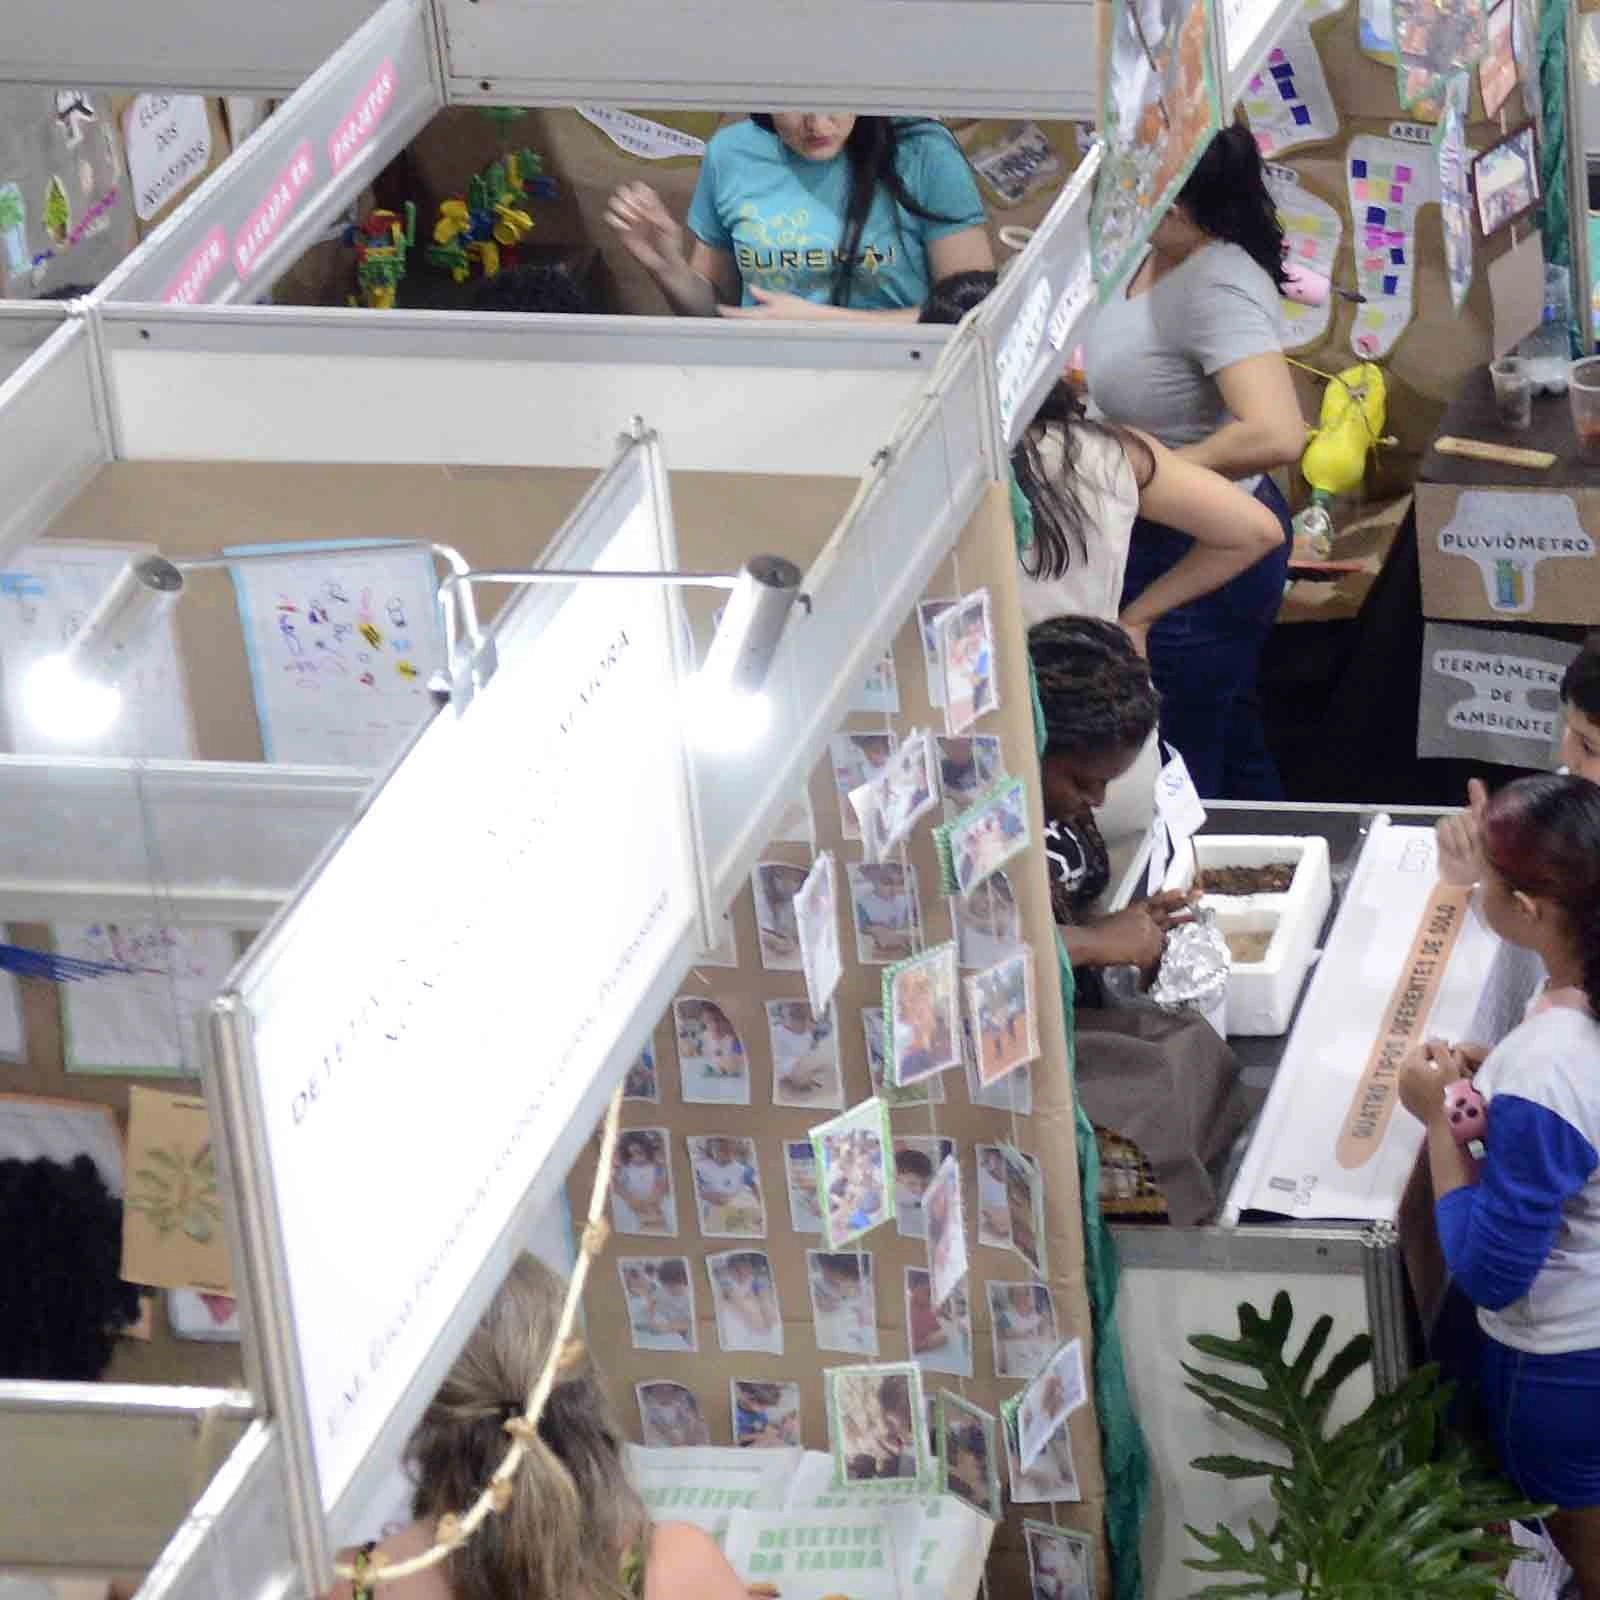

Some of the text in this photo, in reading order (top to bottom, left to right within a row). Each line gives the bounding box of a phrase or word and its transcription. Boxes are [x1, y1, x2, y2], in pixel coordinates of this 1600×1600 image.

[1393, 125, 1430, 140] AREI
[1438, 656, 1560, 683] TERMÔMETR
[1490, 687, 1513, 703] DE
[1454, 710, 1553, 735] AMBIENTE
[1350, 1076, 1390, 1141] QUATRO
